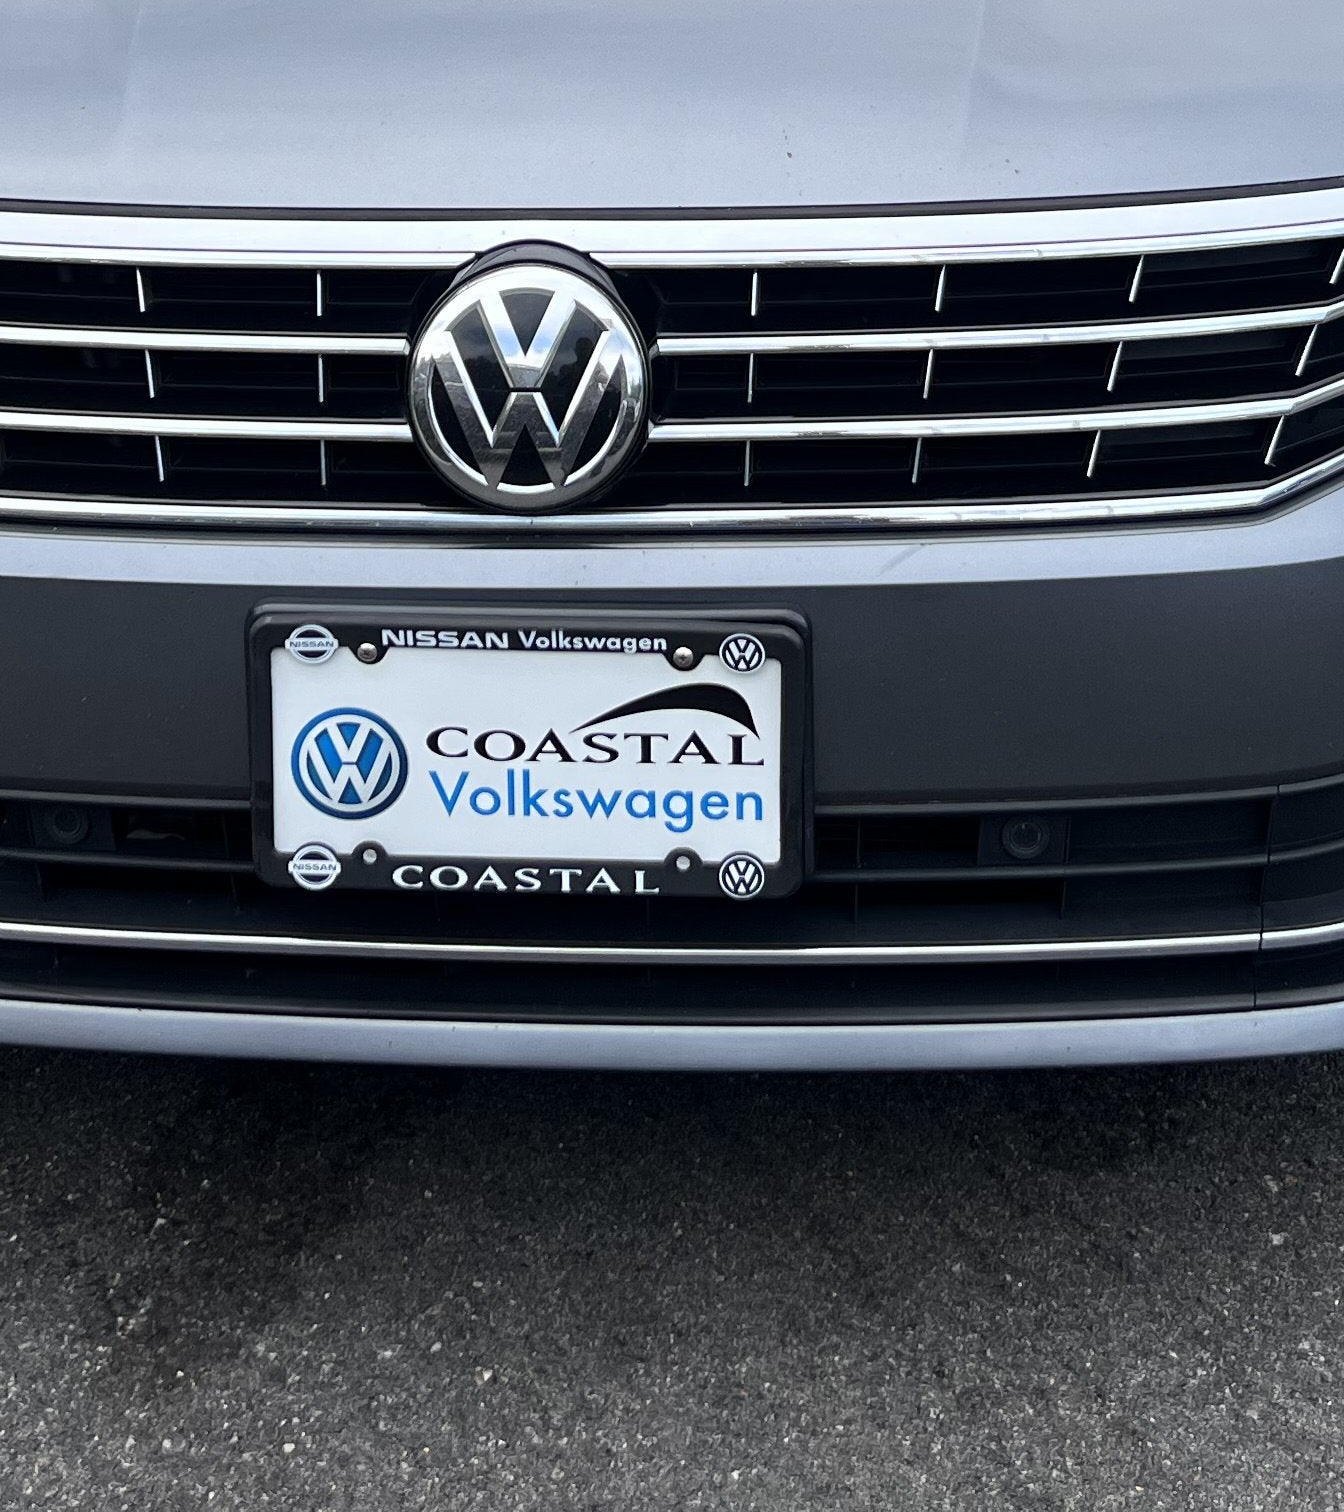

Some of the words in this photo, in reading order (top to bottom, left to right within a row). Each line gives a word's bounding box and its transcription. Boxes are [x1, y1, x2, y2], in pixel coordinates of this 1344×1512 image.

[288, 640, 335, 649] NISSAN
[381, 629, 509, 650] NISSAN
[518, 628, 668, 654] Volkswagen
[426, 726, 765, 767] COASTAL
[429, 768, 764, 833] Volkswagen
[292, 863, 337, 872] NISSAN
[392, 865, 660, 895] COASTAL
